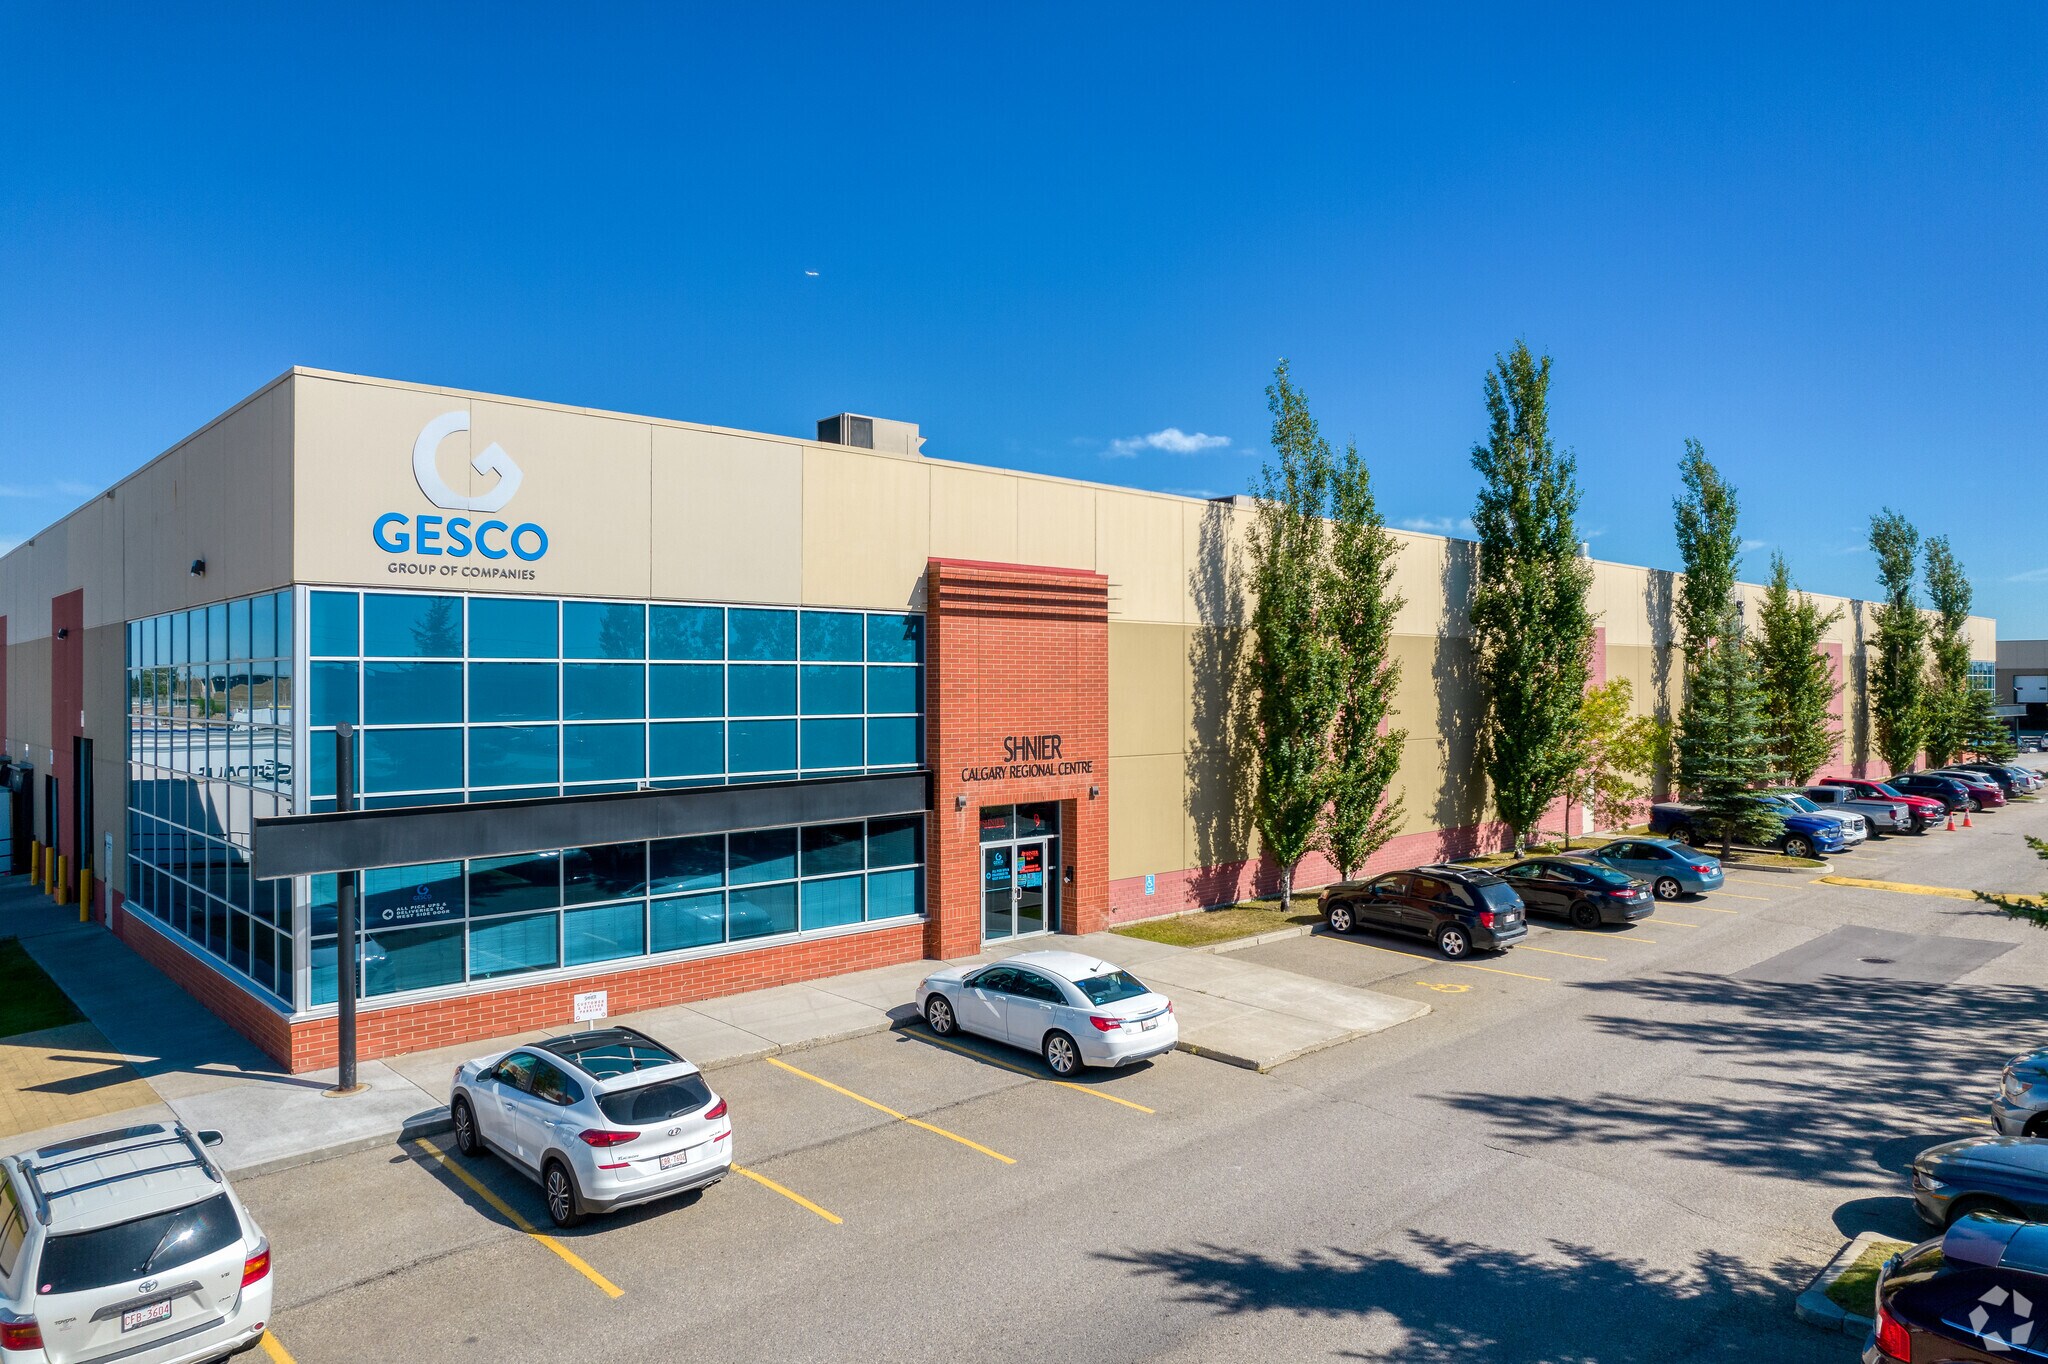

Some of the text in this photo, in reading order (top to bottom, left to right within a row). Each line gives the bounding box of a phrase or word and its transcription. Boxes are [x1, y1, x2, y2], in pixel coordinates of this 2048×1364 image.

[373, 512, 549, 562] GESCO
[388, 562, 536, 580] GROUP OF COMPANIES
[1003, 734, 1062, 763] SHNIER
[961, 760, 1093, 782] CALGARY REGIONAL CENTRE
[54, 1316, 77, 1325] TOYOTA
